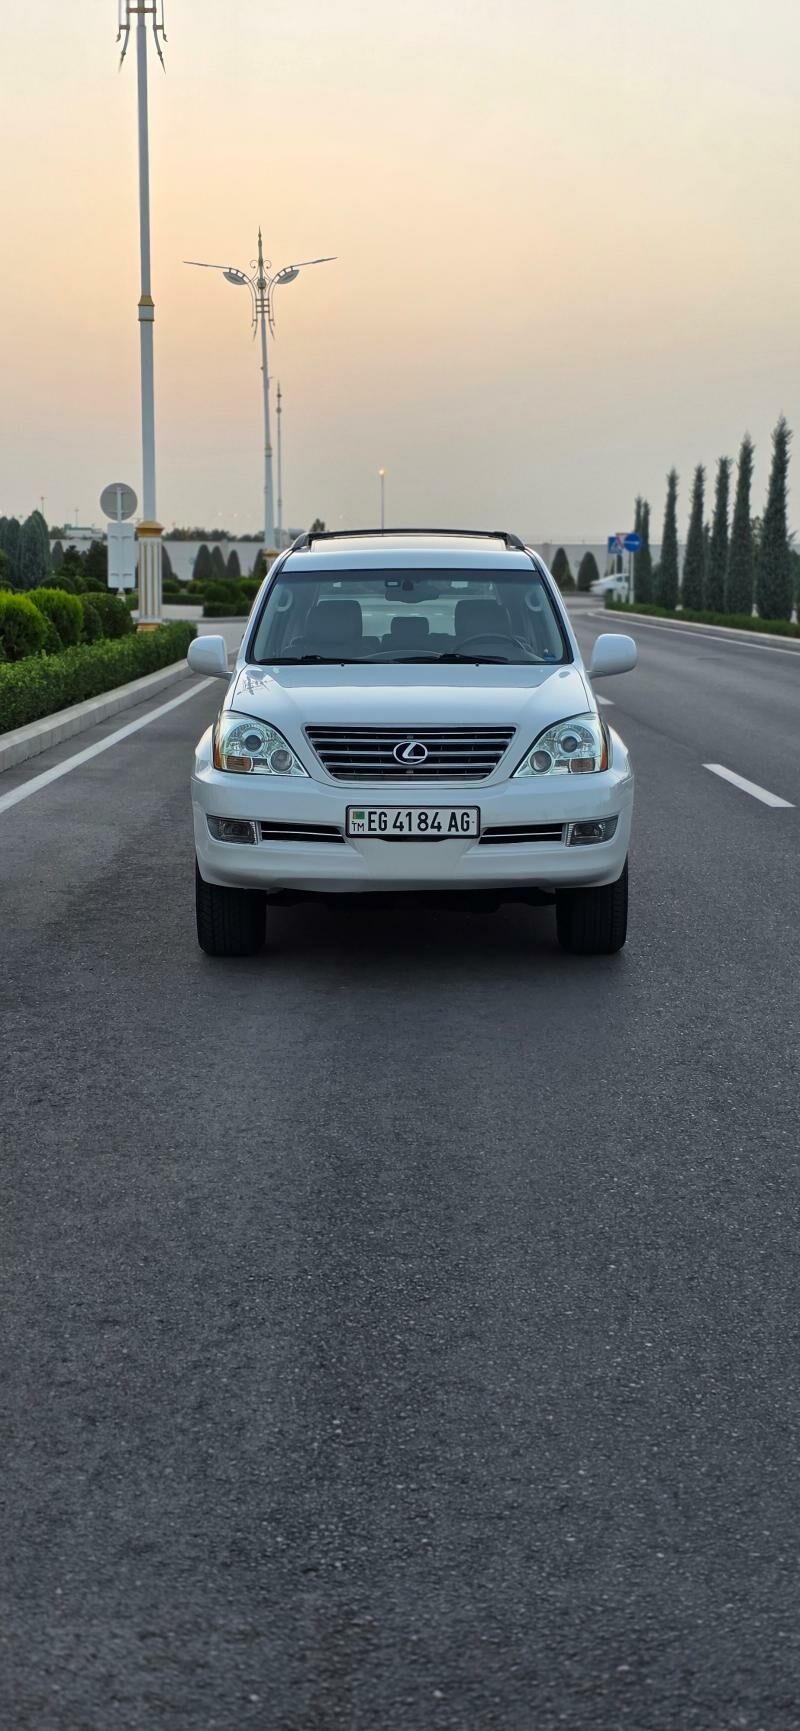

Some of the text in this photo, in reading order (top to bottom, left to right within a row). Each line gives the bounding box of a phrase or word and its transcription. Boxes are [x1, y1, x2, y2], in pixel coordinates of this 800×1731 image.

[352, 822, 365, 832] TM
[368, 811, 470, 832] EG 4184 AG
